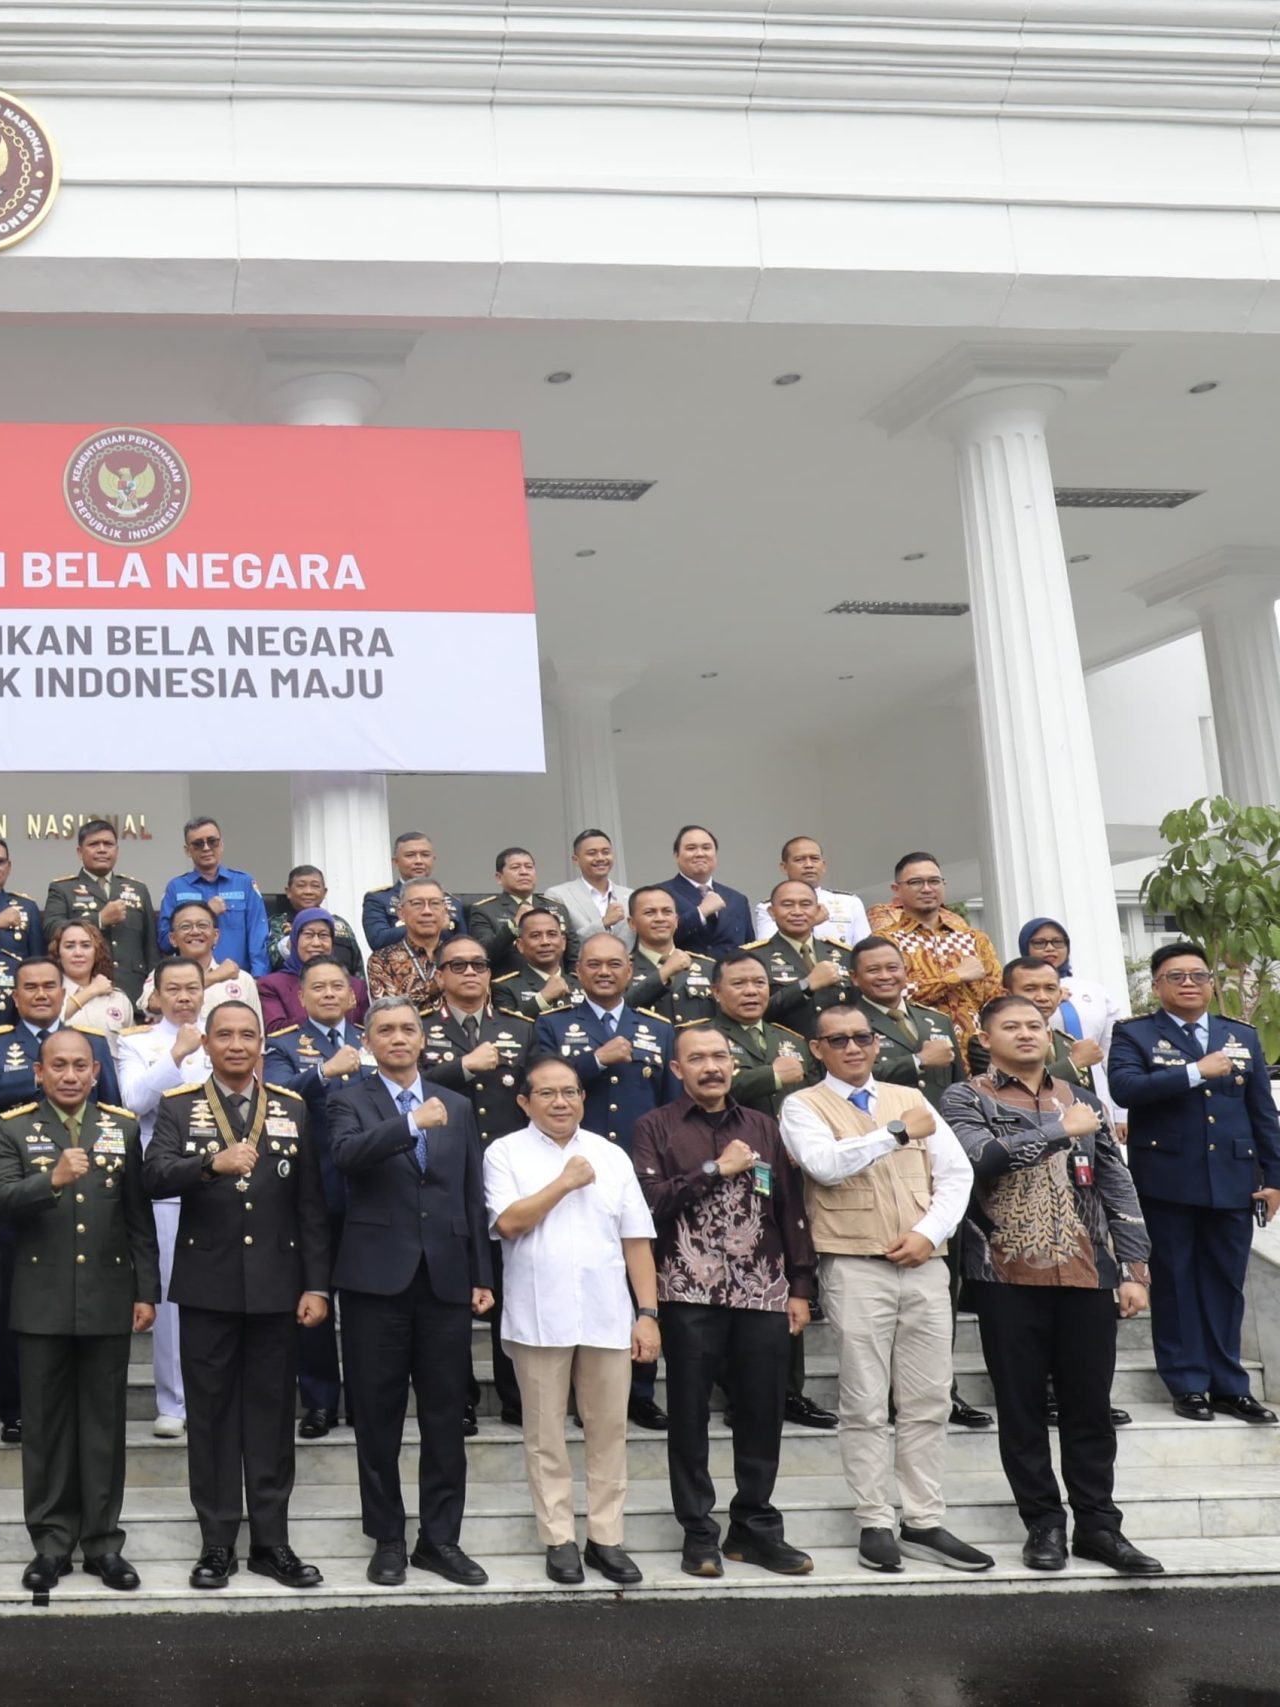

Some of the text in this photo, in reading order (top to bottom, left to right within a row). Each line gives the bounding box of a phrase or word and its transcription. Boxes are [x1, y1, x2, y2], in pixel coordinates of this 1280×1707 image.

[3, 108, 45, 162] NASIONAL
[72, 435, 182, 482] KEMENTERIAN PERTAHANAN
[74, 500, 181, 540] REPUBLIK INDONESIA
[22, 551, 151, 588] BELA
[166, 552, 366, 590] NEGARA
[106, 625, 215, 656] BELA
[227, 626, 394, 657] NEGARA
[35, 667, 258, 698] INDONESIA
[270, 668, 383, 699] MAJU
